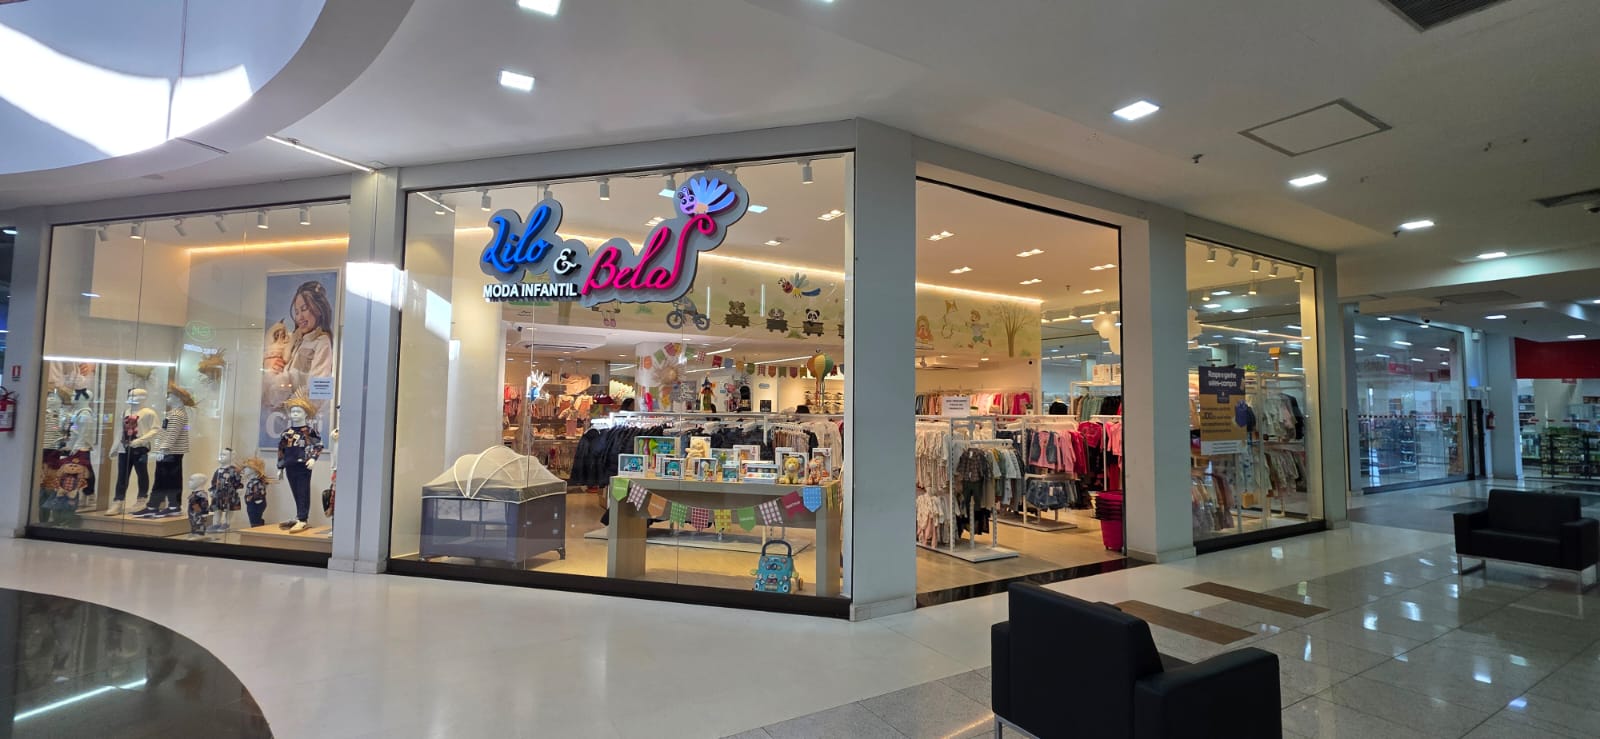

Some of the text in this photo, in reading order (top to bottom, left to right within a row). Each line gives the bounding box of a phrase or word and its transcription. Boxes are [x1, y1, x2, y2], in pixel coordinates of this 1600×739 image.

[483, 204, 717, 296] Lilo & Bela
[483, 283, 578, 298] MODA INFANTIL
